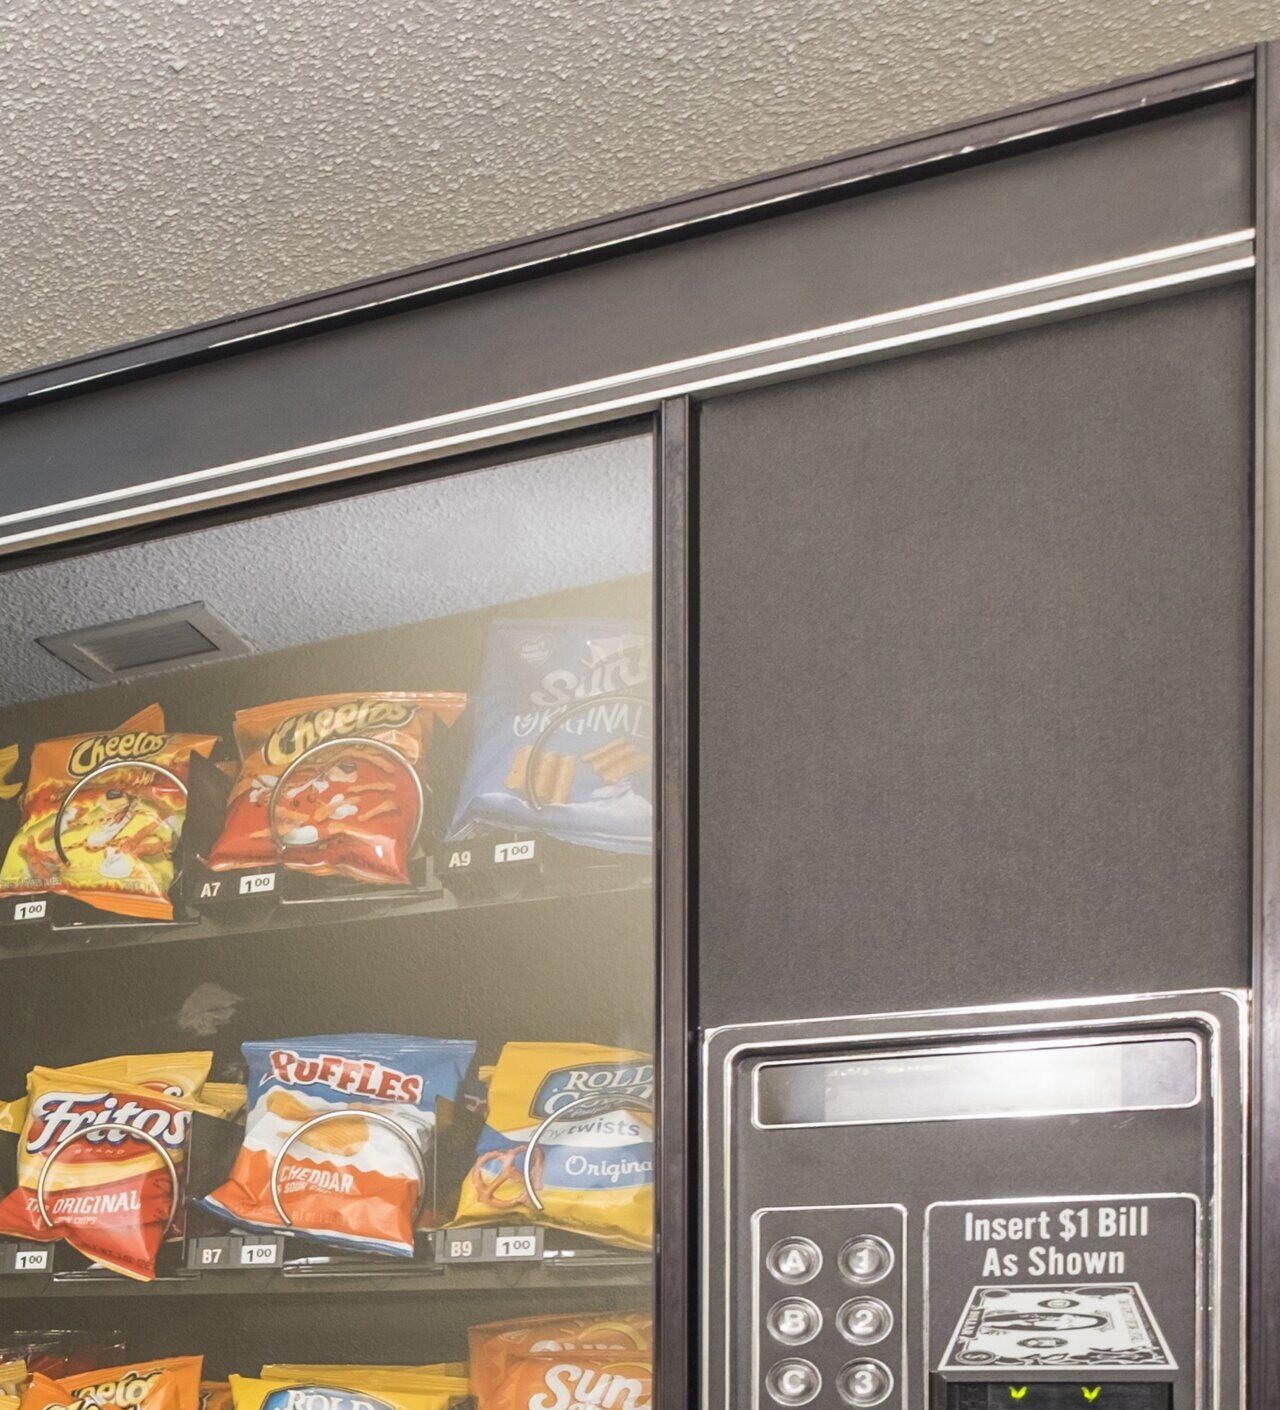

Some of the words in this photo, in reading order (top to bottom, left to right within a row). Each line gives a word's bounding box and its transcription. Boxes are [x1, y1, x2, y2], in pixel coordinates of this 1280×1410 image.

[264, 702, 418, 765] Cheetos
[69, 732, 169, 777] Cheetos
[448, 850, 472, 868] A9
[199, 881, 222, 899] A7
[260, 1050, 424, 1105] RUFFLES
[26, 1091, 193, 1152] Fritos
[567, 1117, 641, 1137] twists
[279, 1166, 355, 1194] CHEDDAR
[565, 1155, 653, 1183] Origina
[52, 1190, 142, 1215] ORIGINAL
[964, 1211, 1051, 1243] Insert
[1057, 1208, 1092, 1244] $1
[1097, 1206, 1150, 1240] Bill
[202, 1247, 223, 1265] B7
[450, 1241, 473, 1258] B9
[781, 1249, 806, 1271] A
[855, 1249, 872, 1271] 1
[981, 1247, 1019, 1279] As
[1027, 1246, 1127, 1277] Shown
[784, 1310, 805, 1332] B
[853, 1309, 874, 1333] 2
[781, 1371, 805, 1393] C
[853, 1371, 874, 1394] 3
